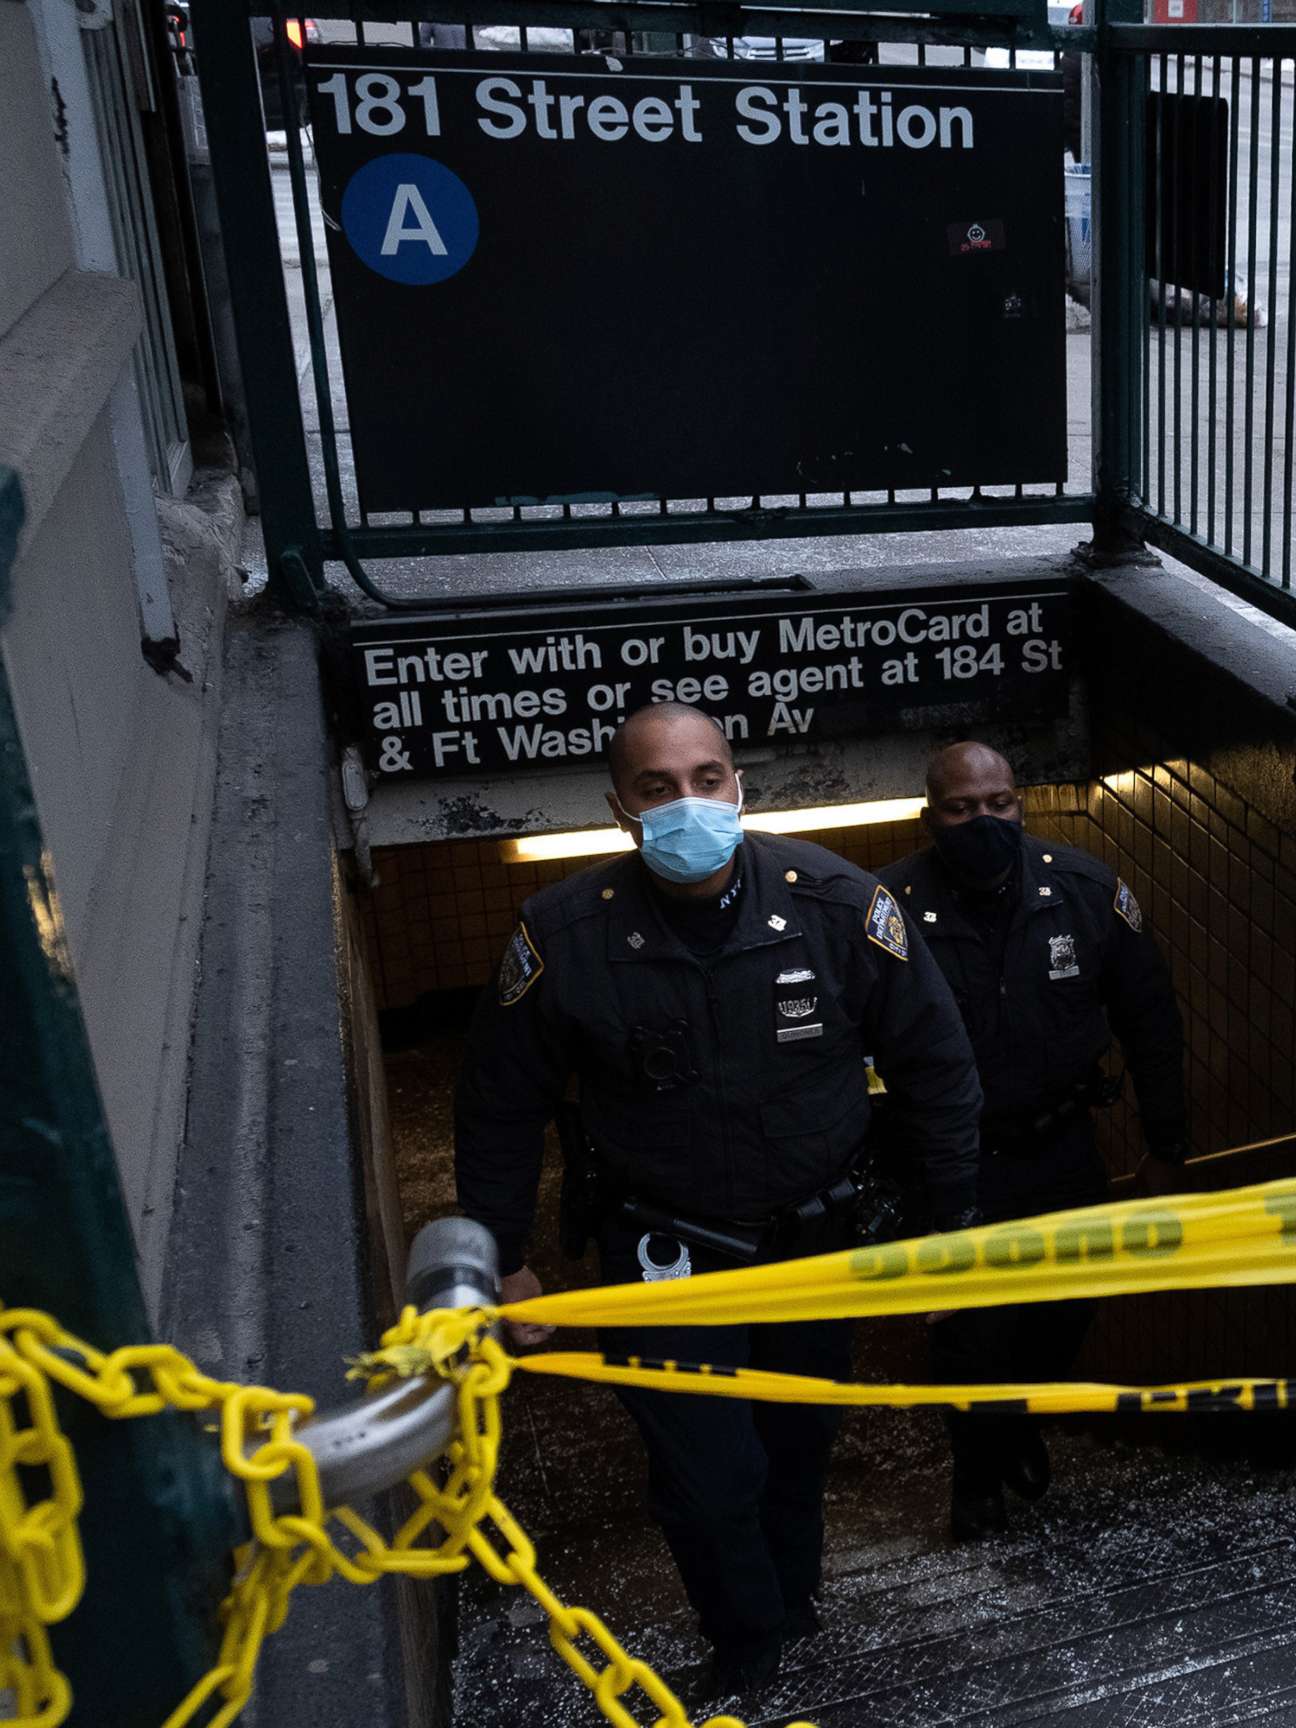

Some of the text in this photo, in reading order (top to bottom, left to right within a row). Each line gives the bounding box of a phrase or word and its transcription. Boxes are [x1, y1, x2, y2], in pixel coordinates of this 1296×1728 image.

[318, 73, 976, 149] 181 Street Station
[380, 183, 449, 256] A
[364, 602, 1043, 686] Enter with or buy MetroCard at
[373, 639, 1063, 730] all times or see agent at 184 St
[378, 701, 815, 772] & Ft Washn Av
